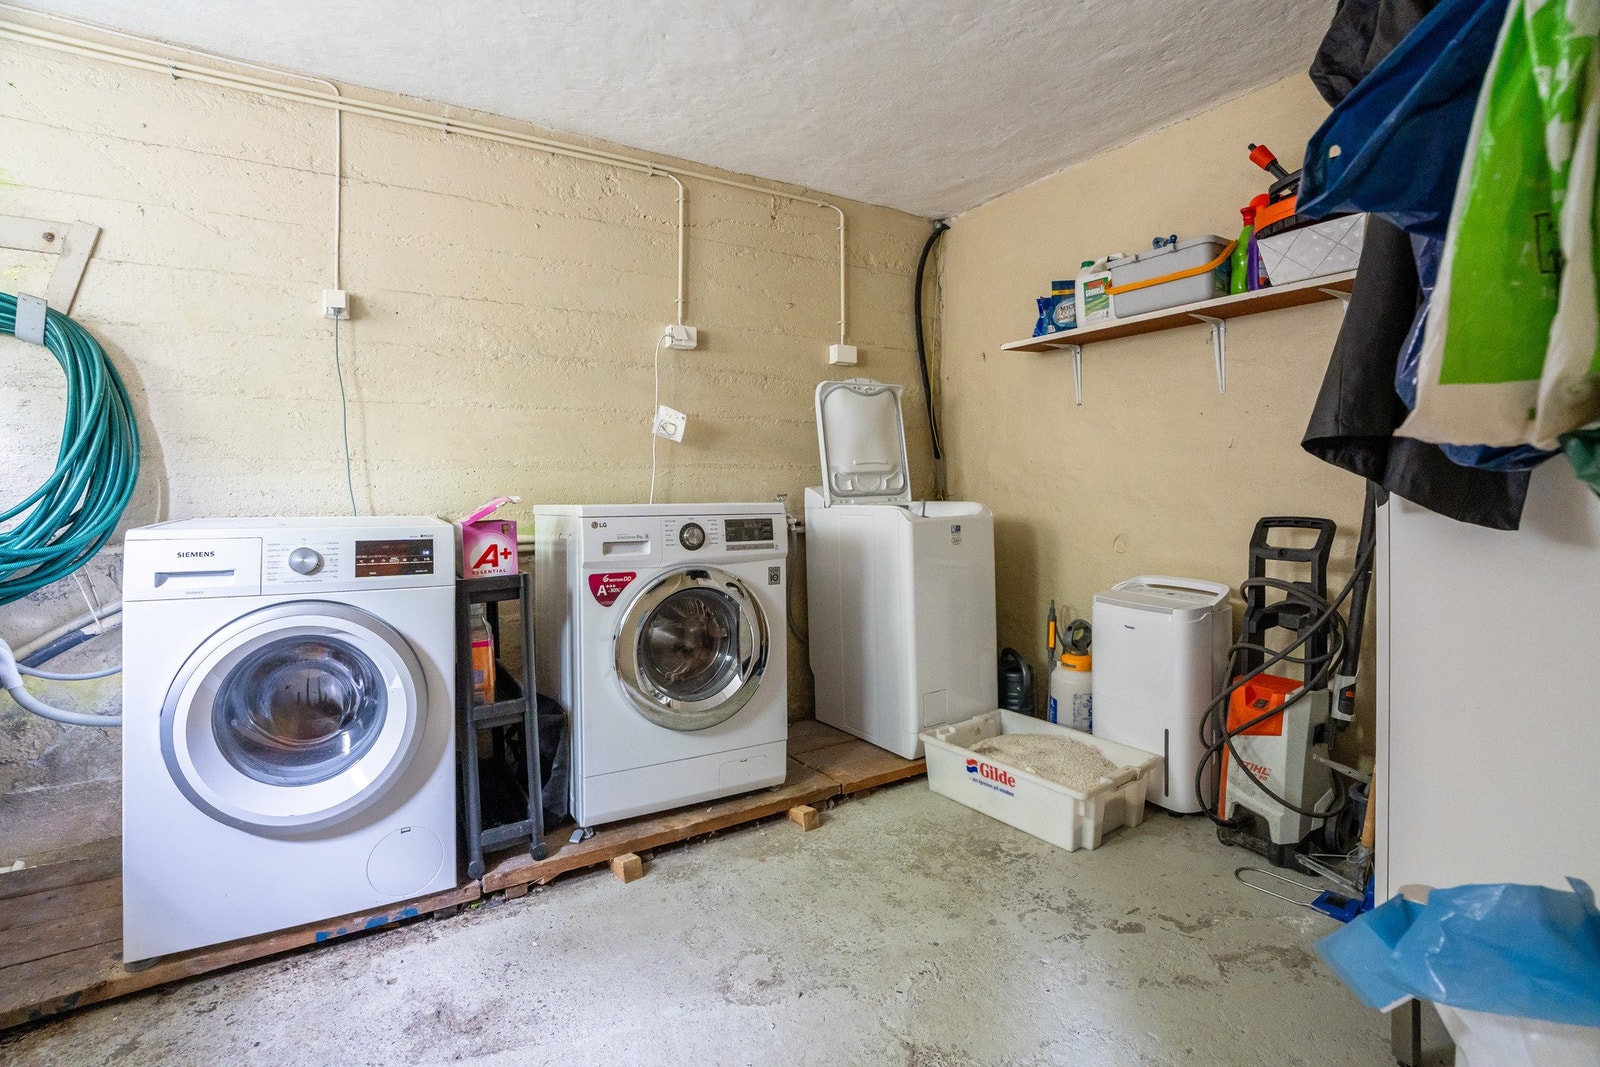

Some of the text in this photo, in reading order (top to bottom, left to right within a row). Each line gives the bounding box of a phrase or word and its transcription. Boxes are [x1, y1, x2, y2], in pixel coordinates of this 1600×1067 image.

[176, 551, 215, 559] SIEMENS
[472, 543, 512, 569] A+
[472, 568, 507, 576] ESSENTIAL
[979, 762, 1016, 788] Gilde
[1237, 760, 1270, 776] TIHL
